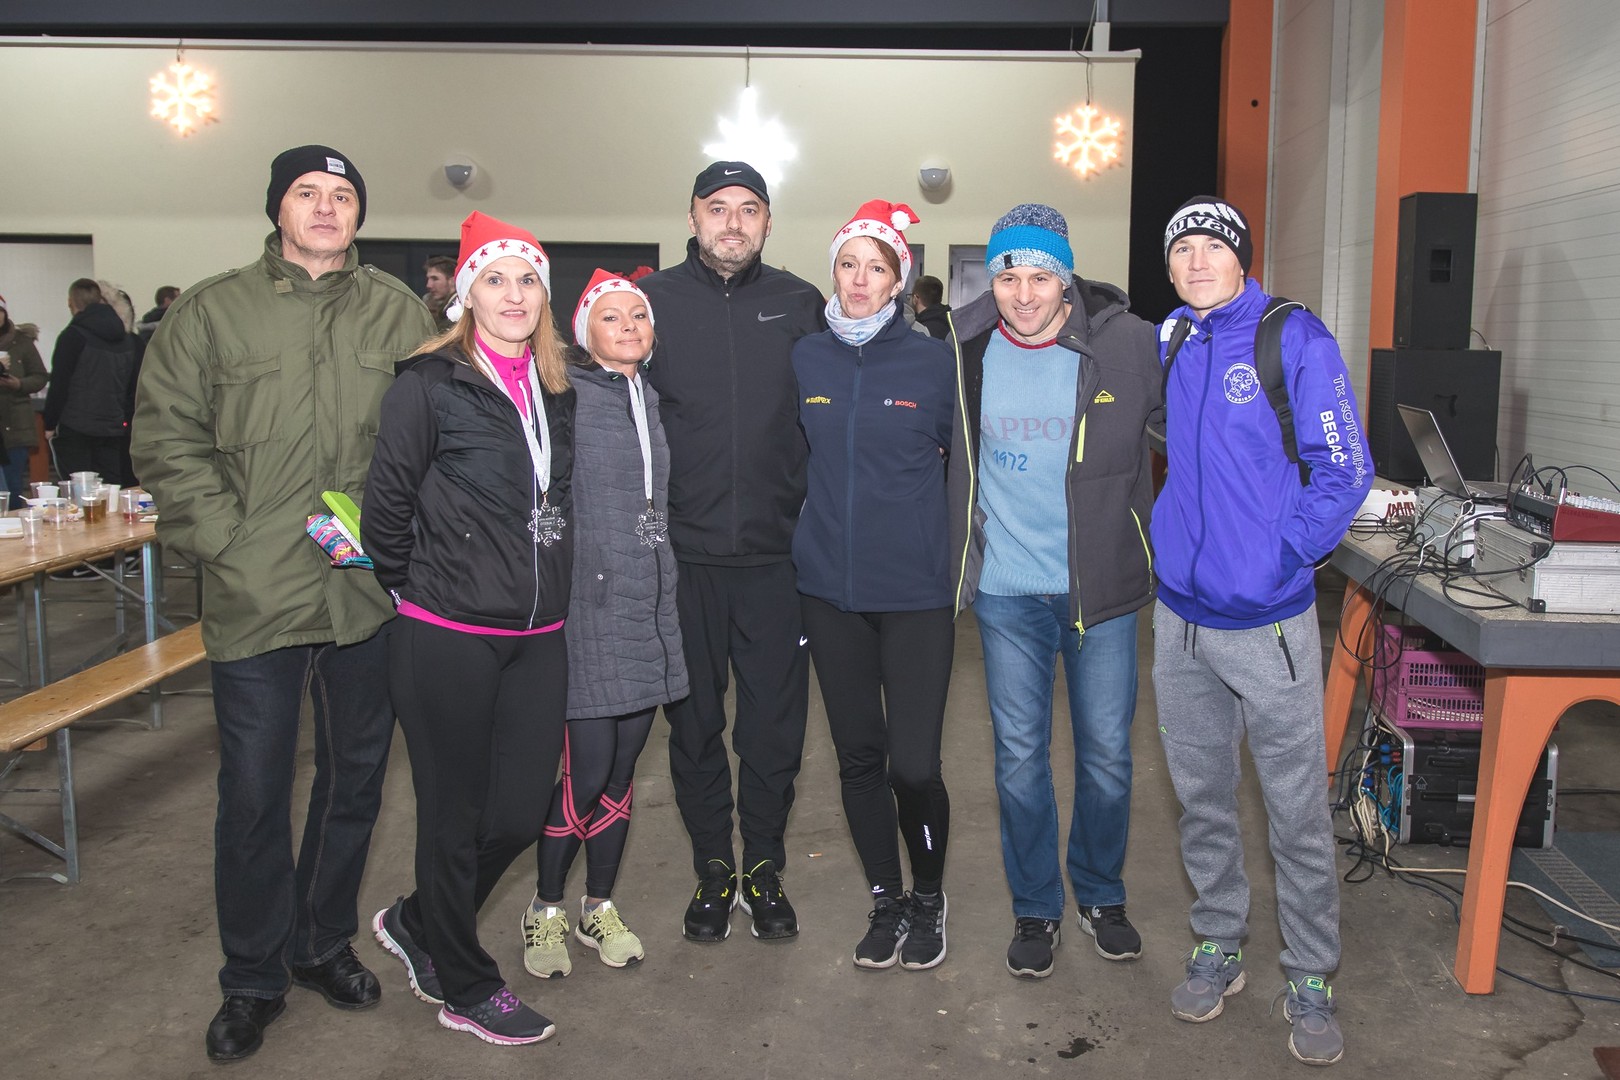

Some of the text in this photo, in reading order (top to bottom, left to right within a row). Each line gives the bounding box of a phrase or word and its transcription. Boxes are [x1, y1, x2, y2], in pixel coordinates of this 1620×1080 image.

[1333, 373, 1346, 398] TK
[894, 400, 917, 410] BOSCH
[992, 449, 1028, 471] 1972
